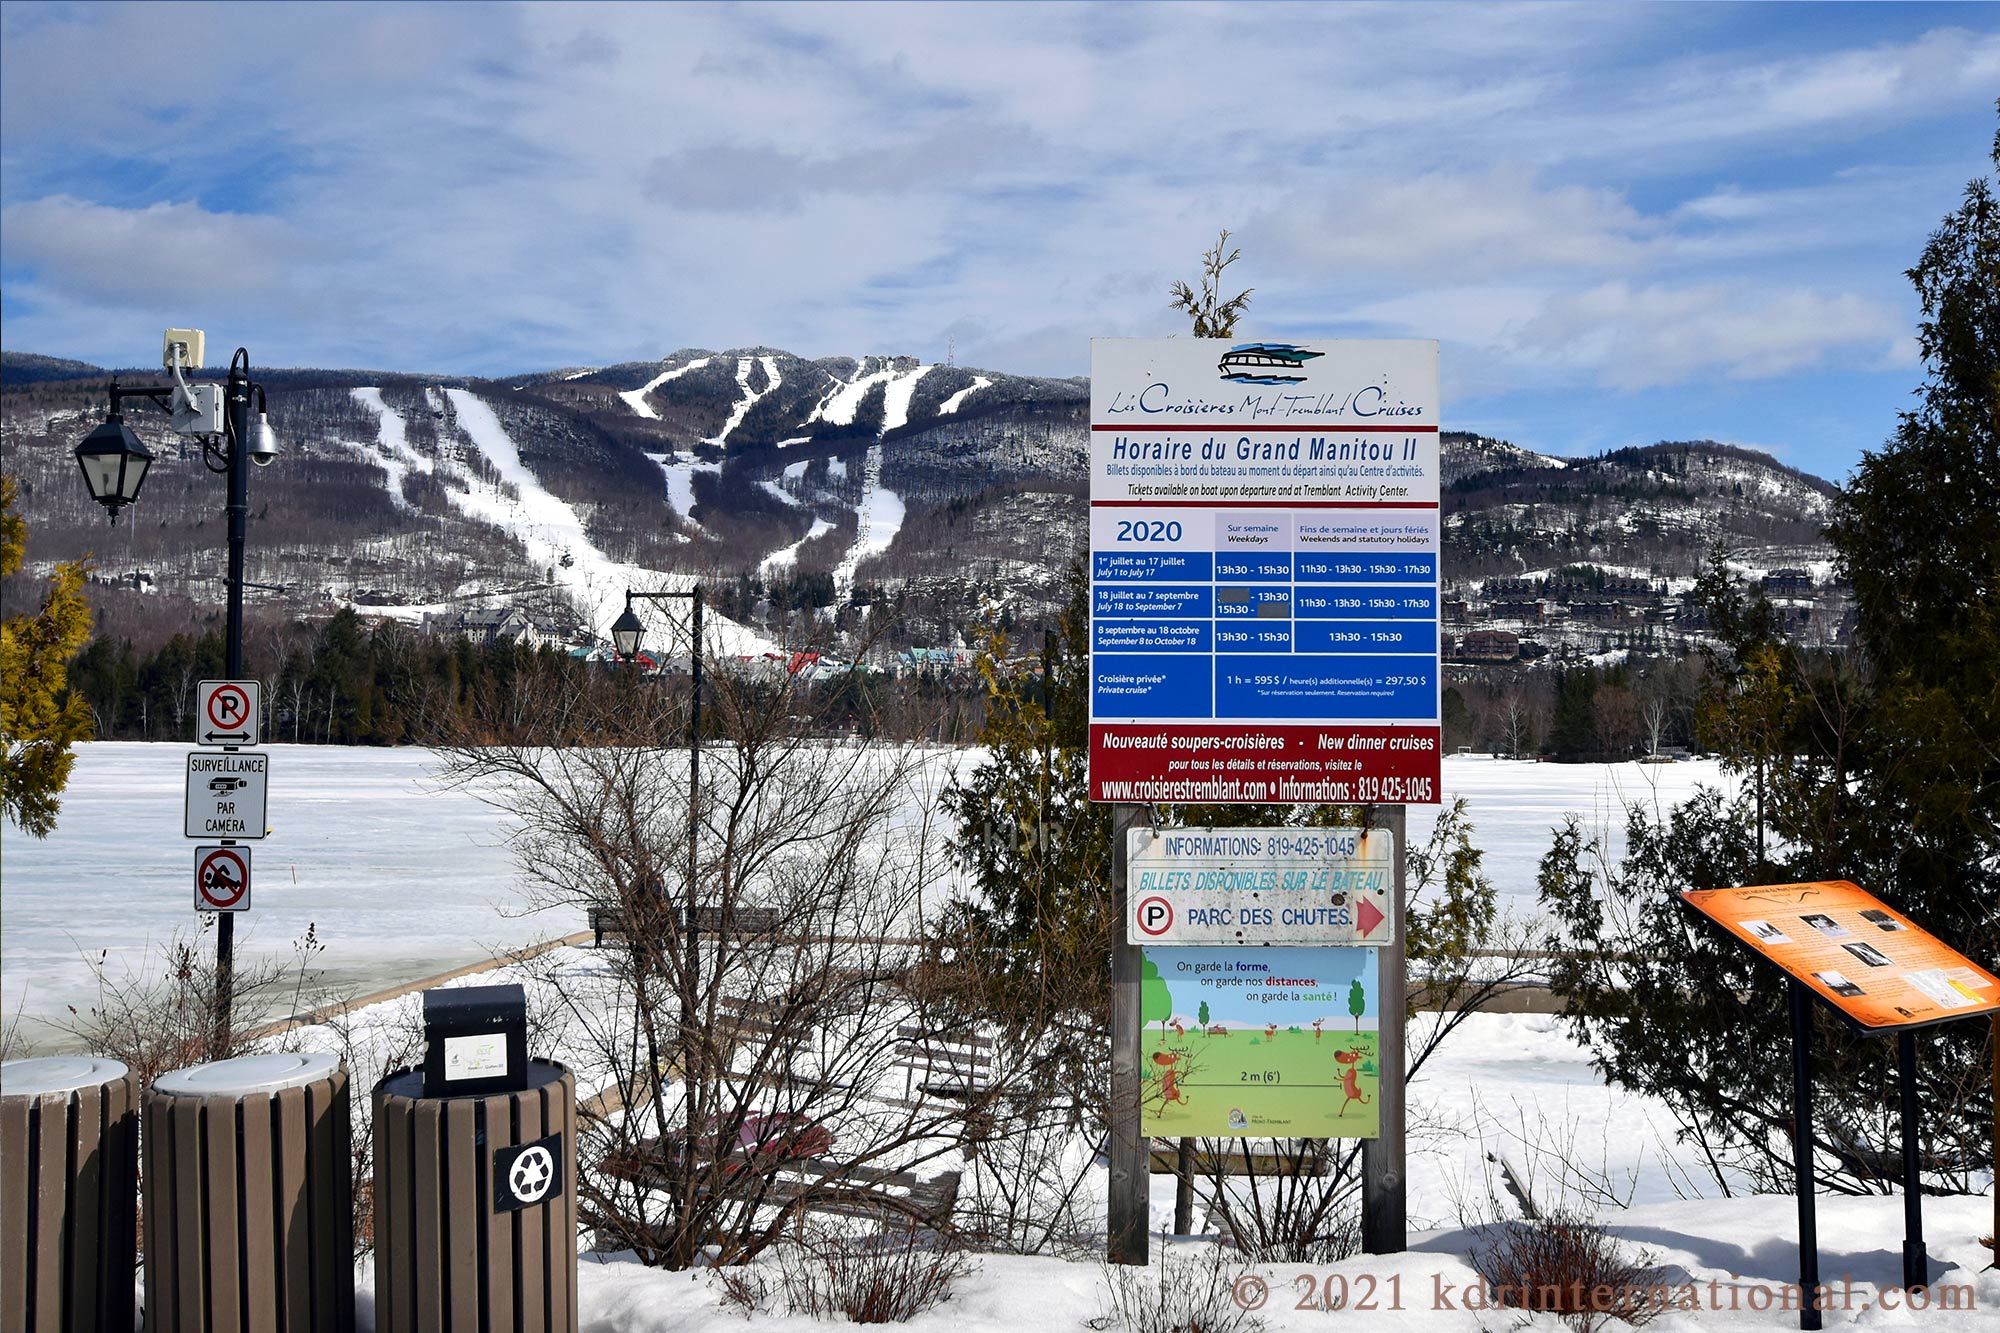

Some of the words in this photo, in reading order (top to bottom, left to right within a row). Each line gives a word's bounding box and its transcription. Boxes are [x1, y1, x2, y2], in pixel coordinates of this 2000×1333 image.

[1352, 386, 1423, 417] Cruises
[1114, 437, 1191, 460] Horaire
[1202, 437, 1226, 460] du
[1237, 437, 1300, 460] Grand
[1309, 438, 1393, 460] Manitou
[1403, 438, 1416, 460] II
[1106, 464, 1129, 475] Billets
[1131, 464, 1172, 478] disponibles
[1180, 464, 1197, 476] bord
[1199, 464, 1208, 476] du
[1211, 464, 1236, 476] bateau
[1238, 467, 1247, 476] au
[1248, 466, 1280, 476] moment
[1282, 465, 1291, 476] du
[1293, 464, 1317, 478] départ
[1319, 465, 1336, 476] ainsi
[1360, 464, 1384, 476] Centre
[1128, 484, 1152, 495] Tickets
[1154, 484, 1188, 495] available
[1190, 487, 1199, 495] on
[1201, 484, 1218, 495] boat
[1220, 487, 1238, 498] upon
[1240, 484, 1276, 498] departure
[1278, 484, 1292, 496] and
[1294, 486, 1302, 496] at
[1304, 484, 1341, 496] Tremblant
[1345, 485, 1377, 498] Activity
[1380, 485, 1408, 496] Center.
[1117, 521, 1182, 542] 2020
[1380, 526, 1402, 535] jours
[1228, 535, 1268, 544] Weekdays
[1397, 536, 1429, 544] holidays
[1110, 557, 1133, 567] juillet
[1160, 557, 1185, 567] juillet
[1097, 568, 1113, 578] July
[1128, 568, 1144, 578] July
[1217, 566, 1247, 574] 13h30
[1258, 566, 1289, 574] 15h30
[1301, 565, 1327, 573] 11h30
[1336, 565, 1361, 573] 13h30
[1370, 565, 1396, 573] 15h30
[1404, 565, 1430, 574] 17h30
[1099, 591, 1108, 599] 18
[1110, 591, 1134, 601] juillet
[1156, 592, 1199, 601] septembre
[1258, 592, 1288, 602] 13h30
[1096, 602, 1113, 611] July
[1134, 602, 1176, 611] September
[1300, 599, 1326, 607] 11h30
[1334, 599, 1360, 607] 13h30
[1369, 599, 1395, 607] 15h30
[1403, 599, 1429, 608] 17h30
[1218, 605, 1248, 614] 15h30
[1105, 626, 1146, 635] septembre
[1159, 626, 1170, 634] 18
[1170, 626, 1199, 634] octobre
[1098, 637, 1138, 646] September
[1153, 637, 1185, 645] October
[1217, 633, 1247, 641] 13h30
[1258, 633, 1289, 641] 15h30
[1330, 633, 1360, 641] 13h30
[1371, 633, 1402, 641] 15h30
[1098, 675, 1134, 683] Croisière
[1290, 678, 1318, 686] heure(s)
[1320, 678, 1372, 686] additionnelle(s)
[1386, 676, 1418, 686] 297,50
[1103, 733, 1168, 748] Nouveauté
[1171, 733, 1284, 752] soupers-croisières
[1318, 734, 1344, 749] New
[1348, 734, 1387, 750] dinner
[1390, 734, 1434, 750] cruises
[191, 759, 264, 773] SURVEILLANCE
[1169, 761, 1189, 772] pour
[1191, 760, 1209, 770] tous
[1212, 759, 1224, 770] les
[1227, 759, 1255, 770] détails
[1257, 760, 1265, 770] et
[1267, 759, 1322, 771] réservations,
[1325, 759, 1352, 770] visitez
[1354, 760, 1362, 770] le
[1102, 776, 1266, 800] www.croisierestremblant.com
[1280, 775, 1349, 800] Informations
[1359, 777, 1378, 800] 819
[1382, 777, 1432, 800] 425-1045
[217, 802, 235, 815] PAR
[205, 817, 245, 832] CAMÉRA
[1268, 836, 1355, 856] 819-425-1045
[1139, 872, 1191, 891] BILLETS
[1194, 872, 1277, 891] DISPONIBLES
[1281, 871, 1307, 891] SUR
[1311, 871, 1328, 891] LE
[1331, 871, 1384, 891] BATEAU
[1148, 907, 1164, 926] P
[1187, 907, 1234, 927] PARC
[1240, 907, 1275, 925] DES
[1177, 962, 1192, 971] On
[1195, 961, 1221, 974] garde
[1225, 961, 1233, 971] la
[1236, 961, 1270, 972] forme,
[1200, 978, 1213, 986] on
[1215, 976, 1243, 989] garde
[1245, 978, 1263, 987] nos
[1265, 976, 1319, 988] distances,
[1262, 991, 1288, 1003] garde
[1292, 991, 1300, 1001] la
[1303, 992, 1332, 1001] santé
[1241, 1072, 1247, 1081] 2
